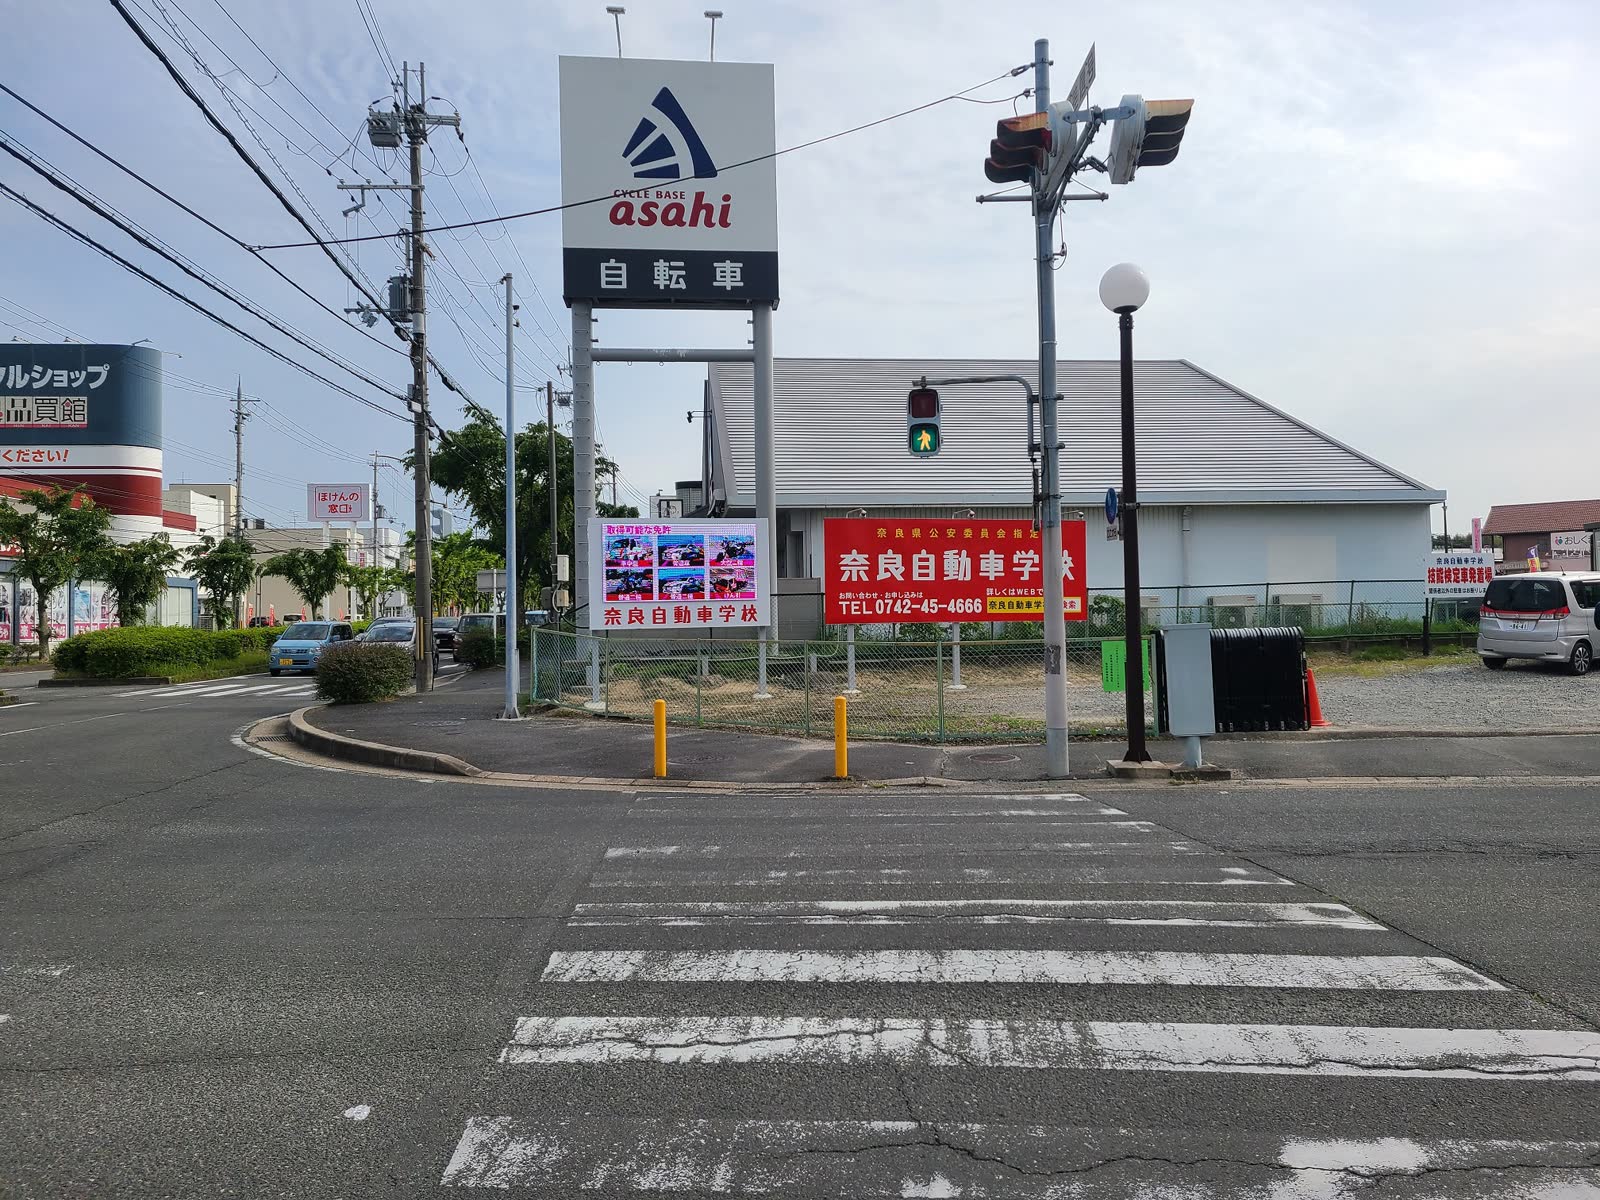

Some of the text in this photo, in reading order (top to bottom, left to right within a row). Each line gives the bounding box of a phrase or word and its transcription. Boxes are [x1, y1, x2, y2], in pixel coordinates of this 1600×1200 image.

[613, 189, 686, 200] CYCLE BASE
[609, 191, 732, 228] asahi
[600, 258, 744, 290] 自転車
[0, 398, 86, 422] 品買館
[318, 492, 359, 502] ほけんの
[328, 504, 347, 513] 窓口
[606, 525, 672, 535] 取得可能な免許
[876, 527, 1039, 539] 奈良県公安委員会指定
[1436, 557, 1484, 565] 奈良自動車学校
[1427, 567, 1493, 583] 技能検定車発着場
[838, 592, 924, 600] お問い合わせ・お申し込みは
[986, 587, 1044, 596] 詳しくはWEBで
[839, 599, 982, 615] TEL 0742-45-4666
[988, 600, 1044, 610] 奈良自動車学
[604, 604, 758, 626] 奈良自動車学校
